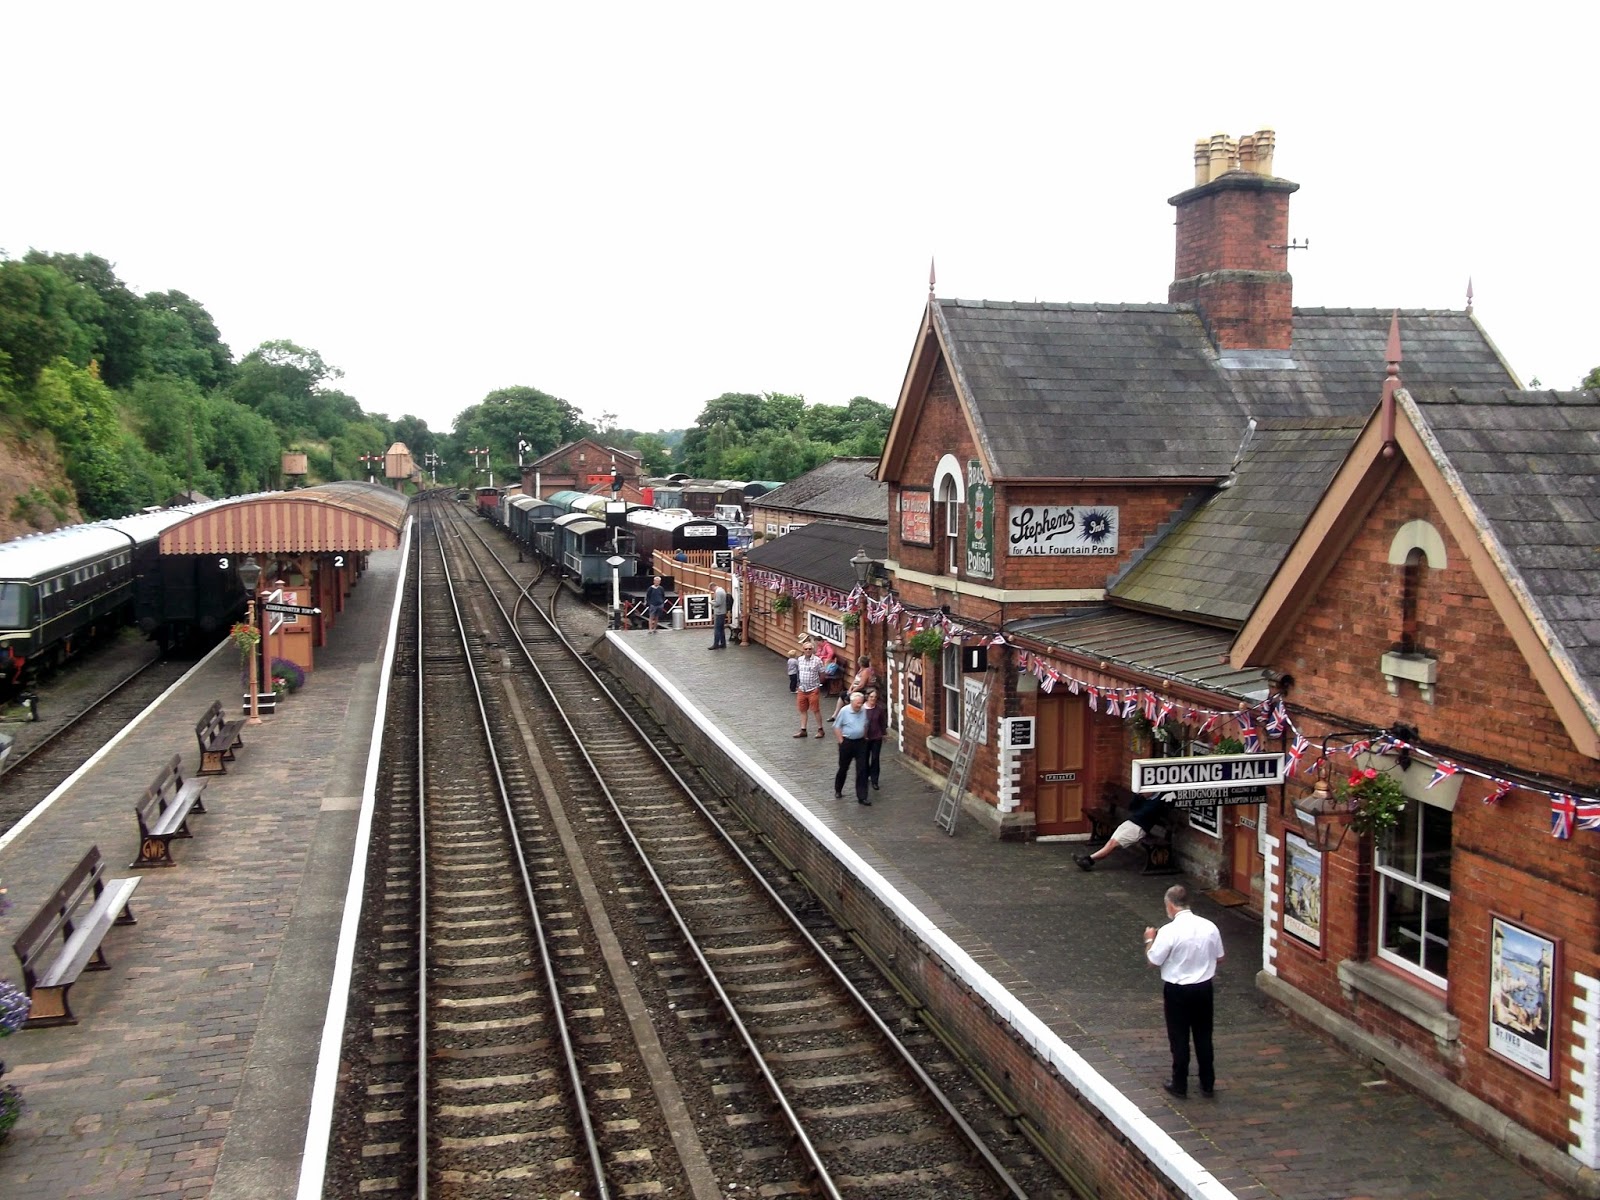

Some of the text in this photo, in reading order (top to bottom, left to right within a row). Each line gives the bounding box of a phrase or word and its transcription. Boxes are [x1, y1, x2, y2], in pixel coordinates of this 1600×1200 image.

[1088, 520, 1106, 535] Ink
[1012, 545, 1115, 555] for ALL Fountain Pens
[218, 558, 229, 569] 3
[334, 555, 344, 567] 2
[968, 551, 991, 573] Polish
[811, 616, 843, 643] BEWDLEY
[908, 681, 922, 704] TEA
[1143, 760, 1275, 785] BOOKING HALL
[1177, 787, 1229, 800] BRIDGNORTH
